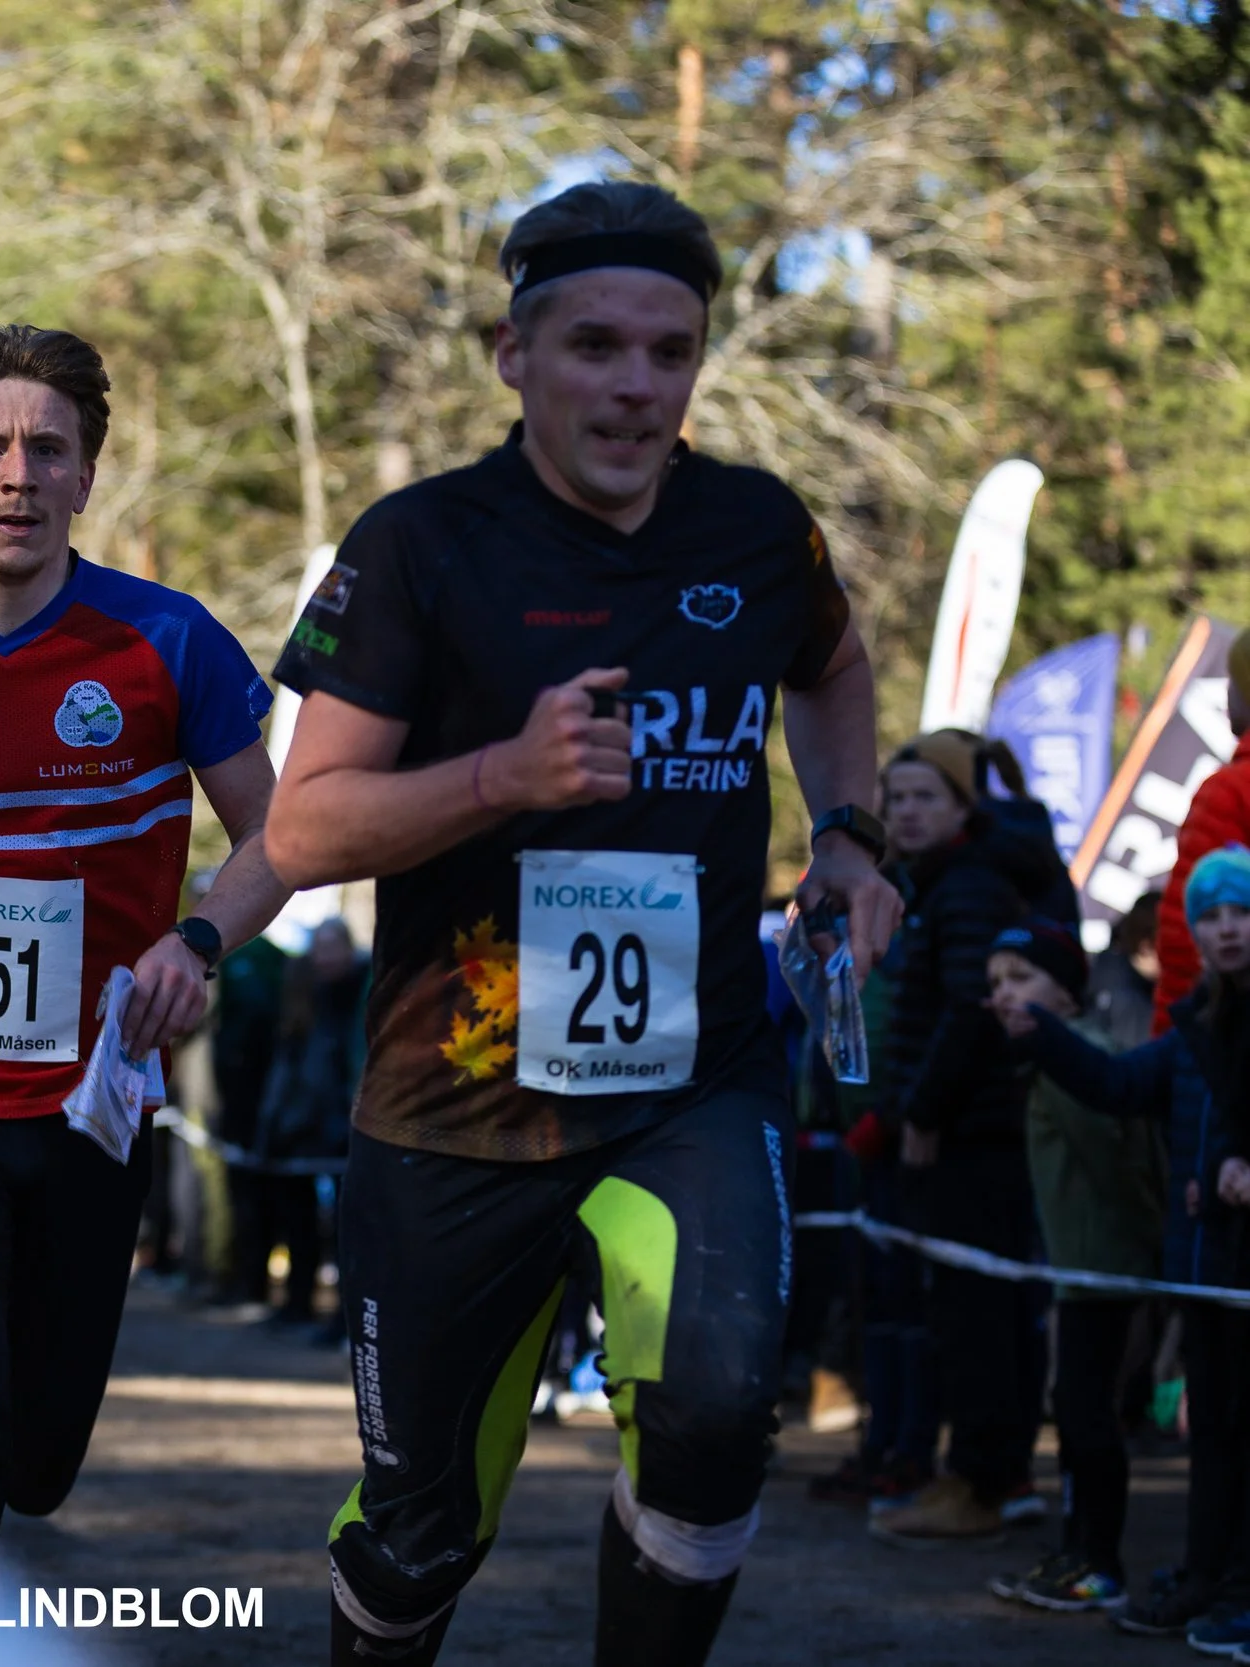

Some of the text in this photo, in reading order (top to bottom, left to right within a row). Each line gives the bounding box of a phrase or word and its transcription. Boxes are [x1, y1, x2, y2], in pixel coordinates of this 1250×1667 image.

[39, 758, 135, 777] LUMONITE
[534, 885, 635, 909] NOREX
[567, 931, 650, 1044] 29
[546, 1059, 666, 1079] OK Måsen
[363, 1297, 387, 1441] PER FORSBERG
